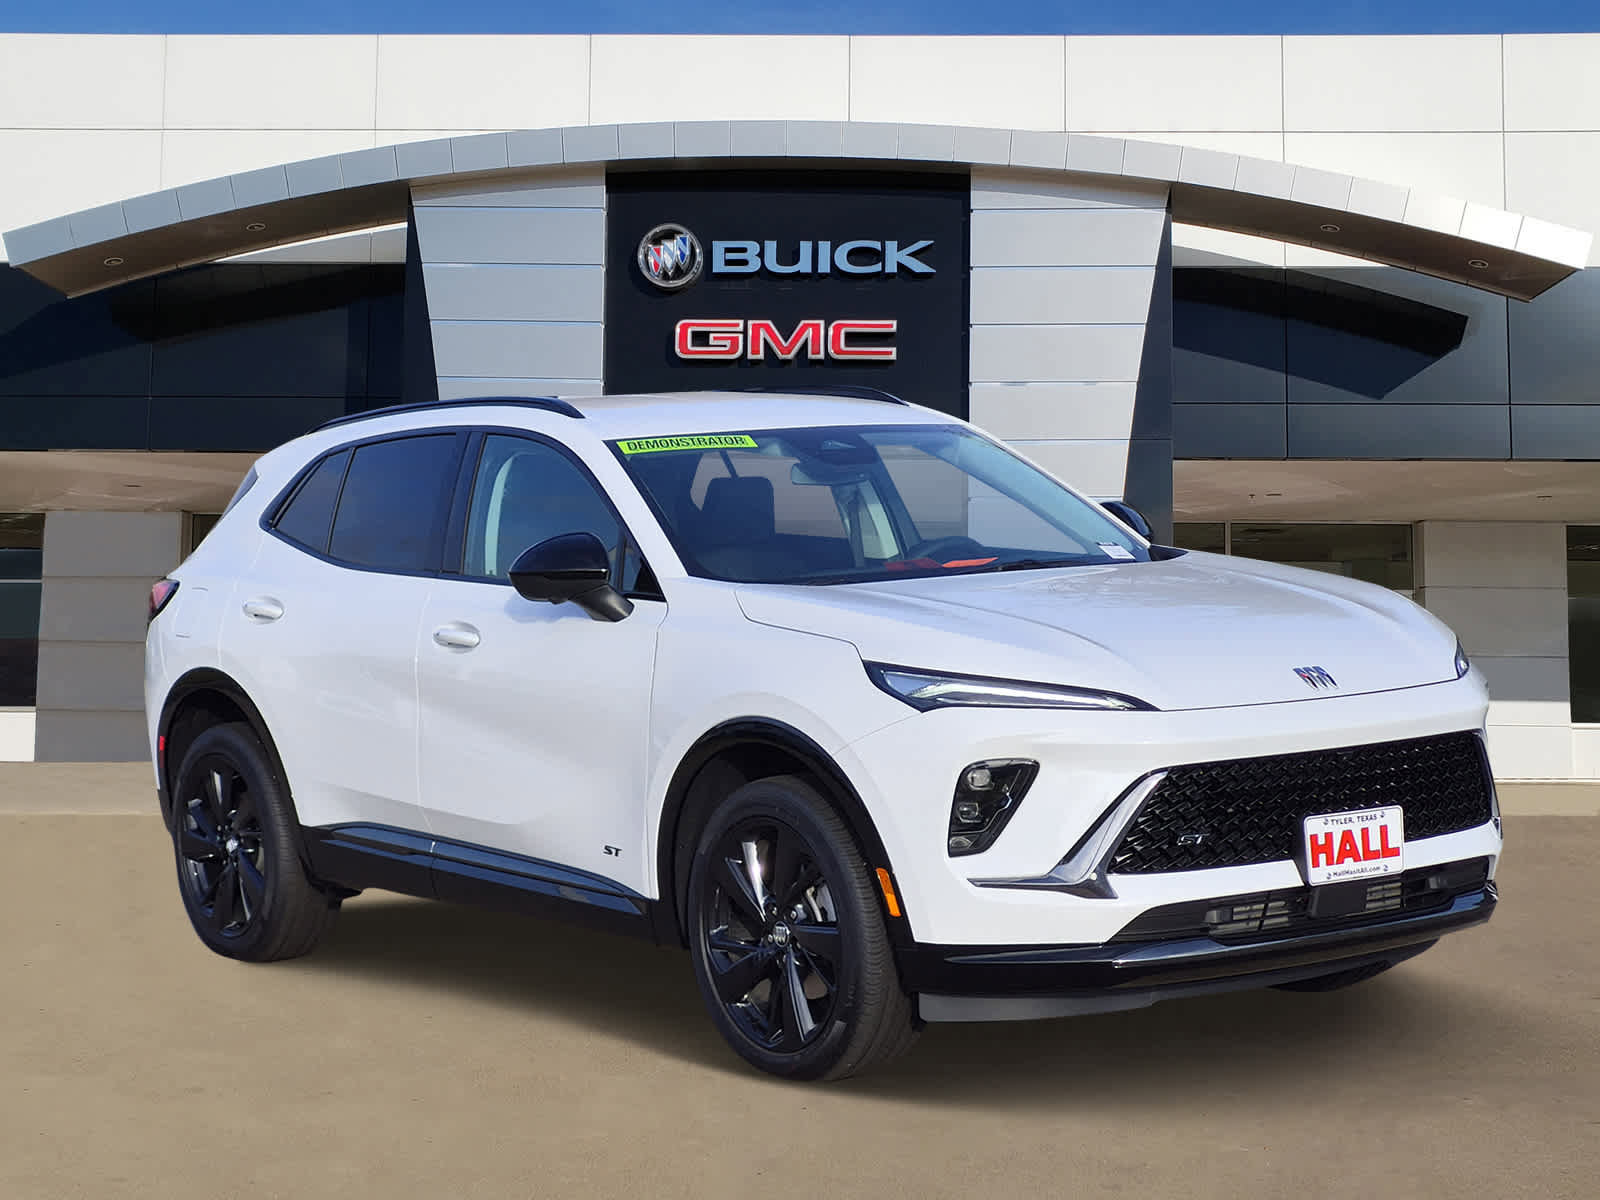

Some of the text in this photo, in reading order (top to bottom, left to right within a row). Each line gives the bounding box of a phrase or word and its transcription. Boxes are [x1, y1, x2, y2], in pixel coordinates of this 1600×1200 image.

[712, 240, 937, 273] BUICK
[675, 319, 898, 360] GMC
[626, 436, 746, 451] DEMONSTRATOR
[1357, 813, 1377, 822] TEXAS
[603, 845, 623, 857] ST
[1310, 824, 1400, 868] HALL
